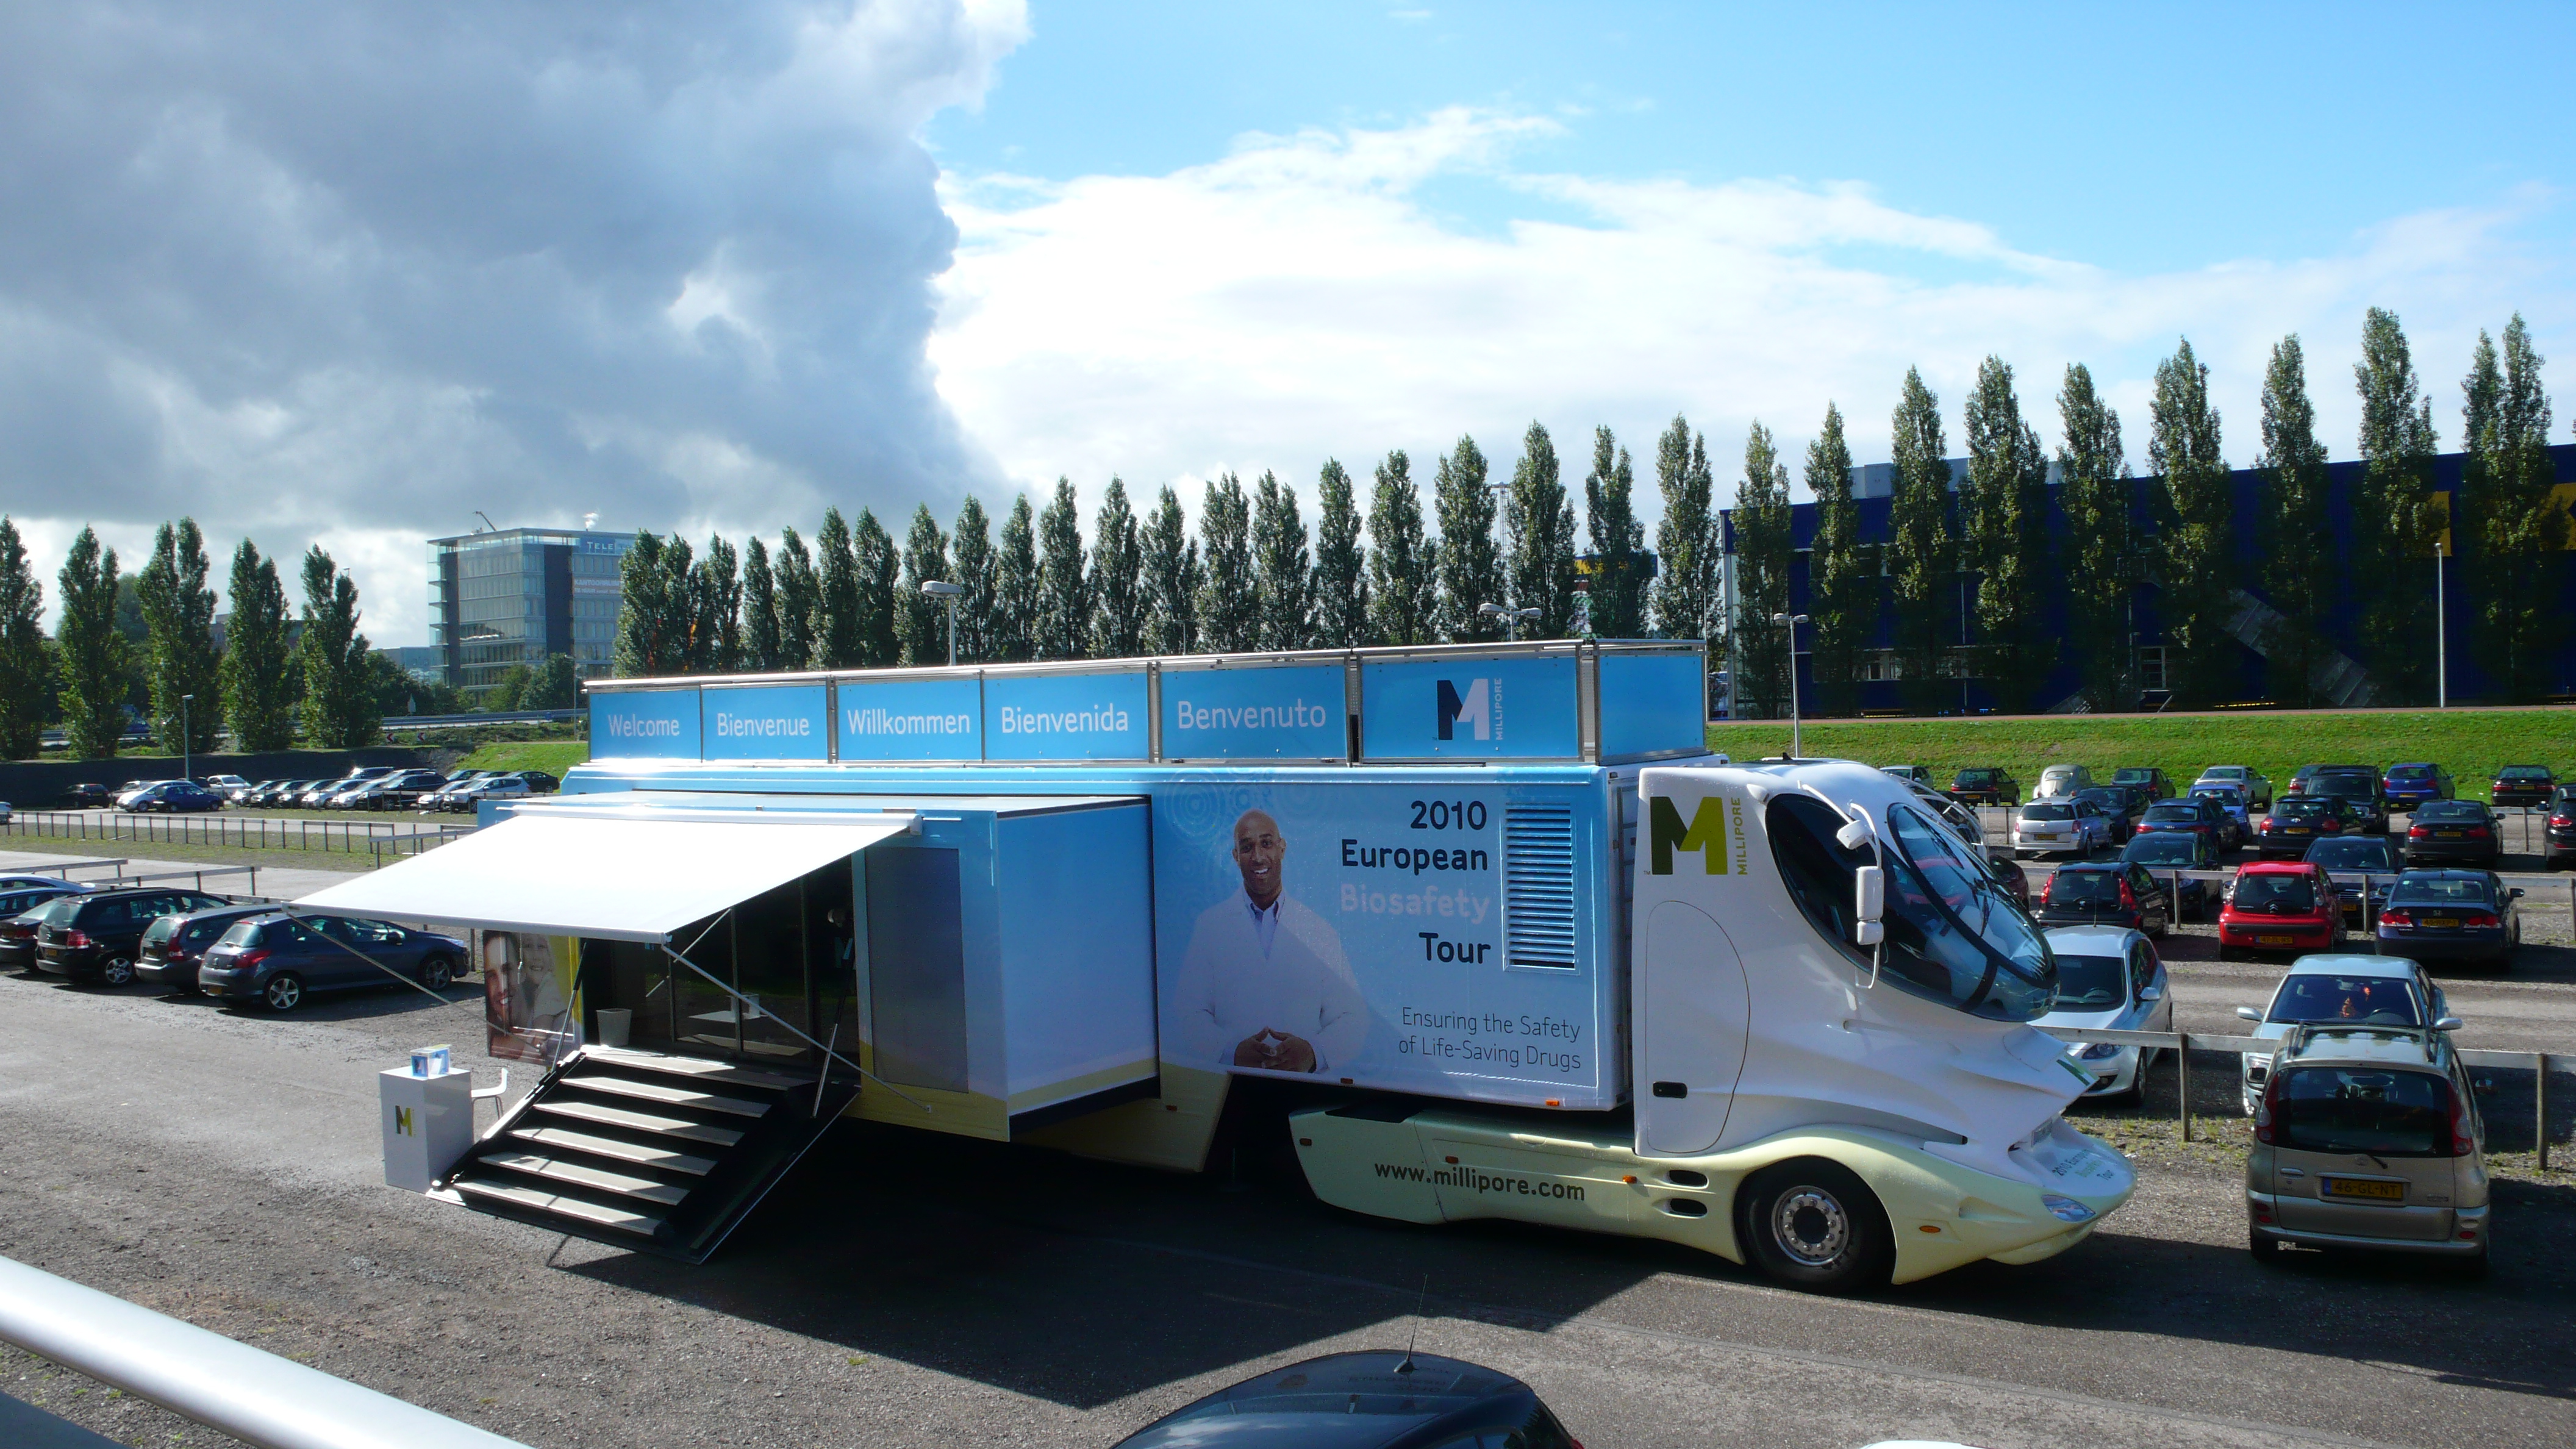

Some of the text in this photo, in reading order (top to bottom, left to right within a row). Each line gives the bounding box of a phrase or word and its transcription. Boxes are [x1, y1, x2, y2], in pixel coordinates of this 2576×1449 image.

[607, 714, 680, 737] Welcome
[717, 713, 810, 737] Bienvenue
[847, 709, 970, 735] Willkommen
[1001, 703, 1128, 734] Bienvenida
[1178, 699, 1326, 729] Benvenuto
[1437, 678, 1490, 740] M
[1494, 678, 1503, 740] MILLIPORE
[1410, 800, 1487, 830] 2010
[1650, 796, 1728, 875] M
[1731, 797, 1748, 875] MILLIPORE
[1342, 839, 1487, 875] European
[1341, 883, 1490, 924] Biosafety
[1419, 932, 1491, 964] Tour
[1403, 1007, 1581, 1043] Ensuring the Safety
[1398, 1036, 1581, 1073] of Life-Saving Drugs
[395, 1104, 412, 1137] M
[1375, 1163, 1585, 1201] www.millipore.com
[2334, 1182, 2398, 1196] 46-GL-NT
